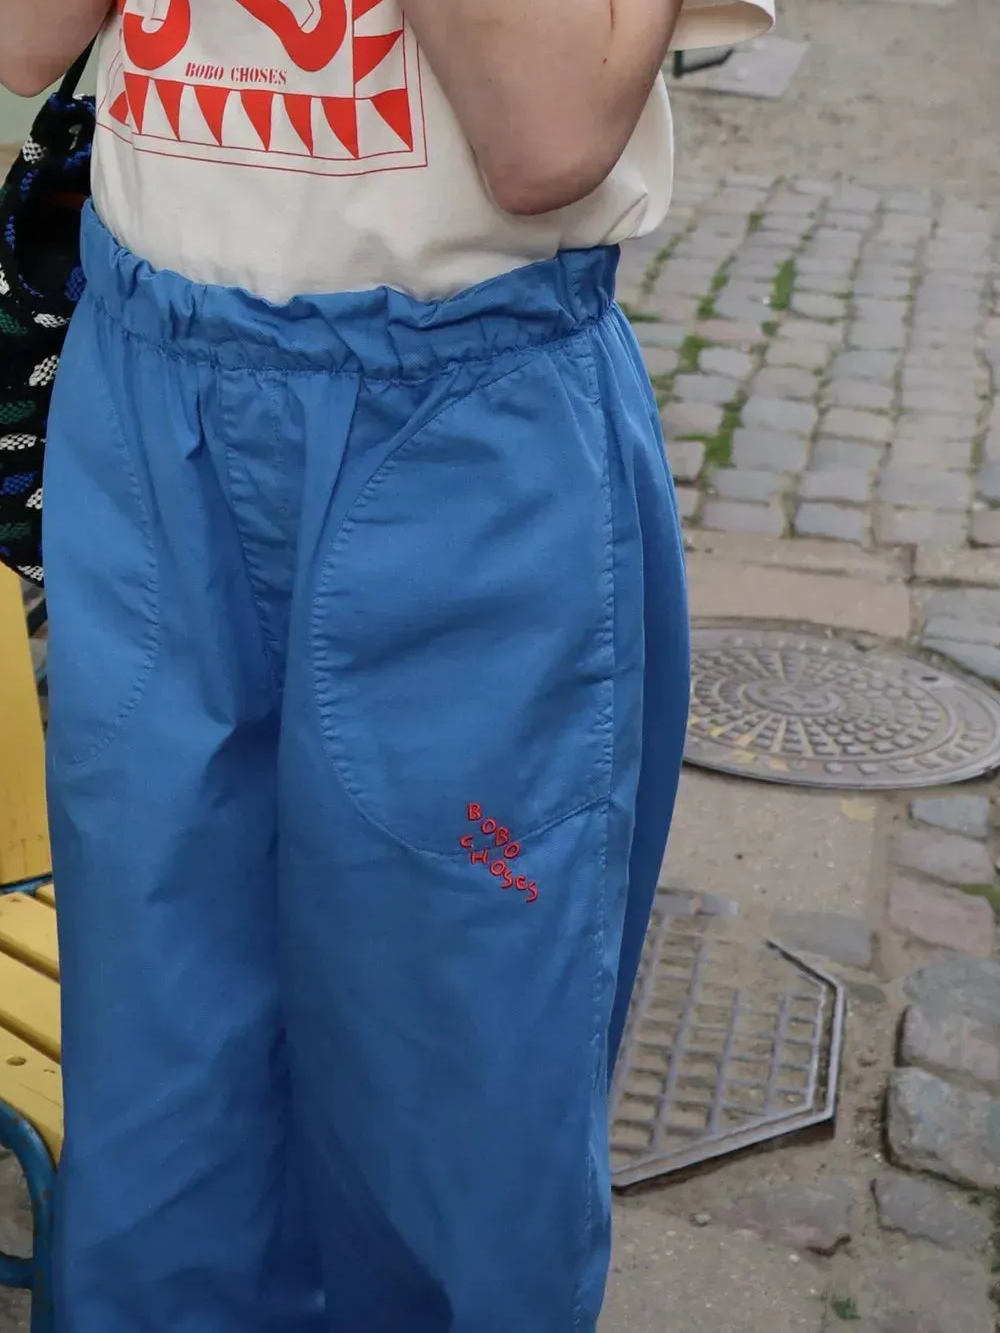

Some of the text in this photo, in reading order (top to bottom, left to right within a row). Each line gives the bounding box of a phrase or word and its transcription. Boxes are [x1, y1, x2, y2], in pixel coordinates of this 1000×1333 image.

[185, 62, 287, 85] BOBO CHOSES
[467, 802, 521, 859] BOBO
